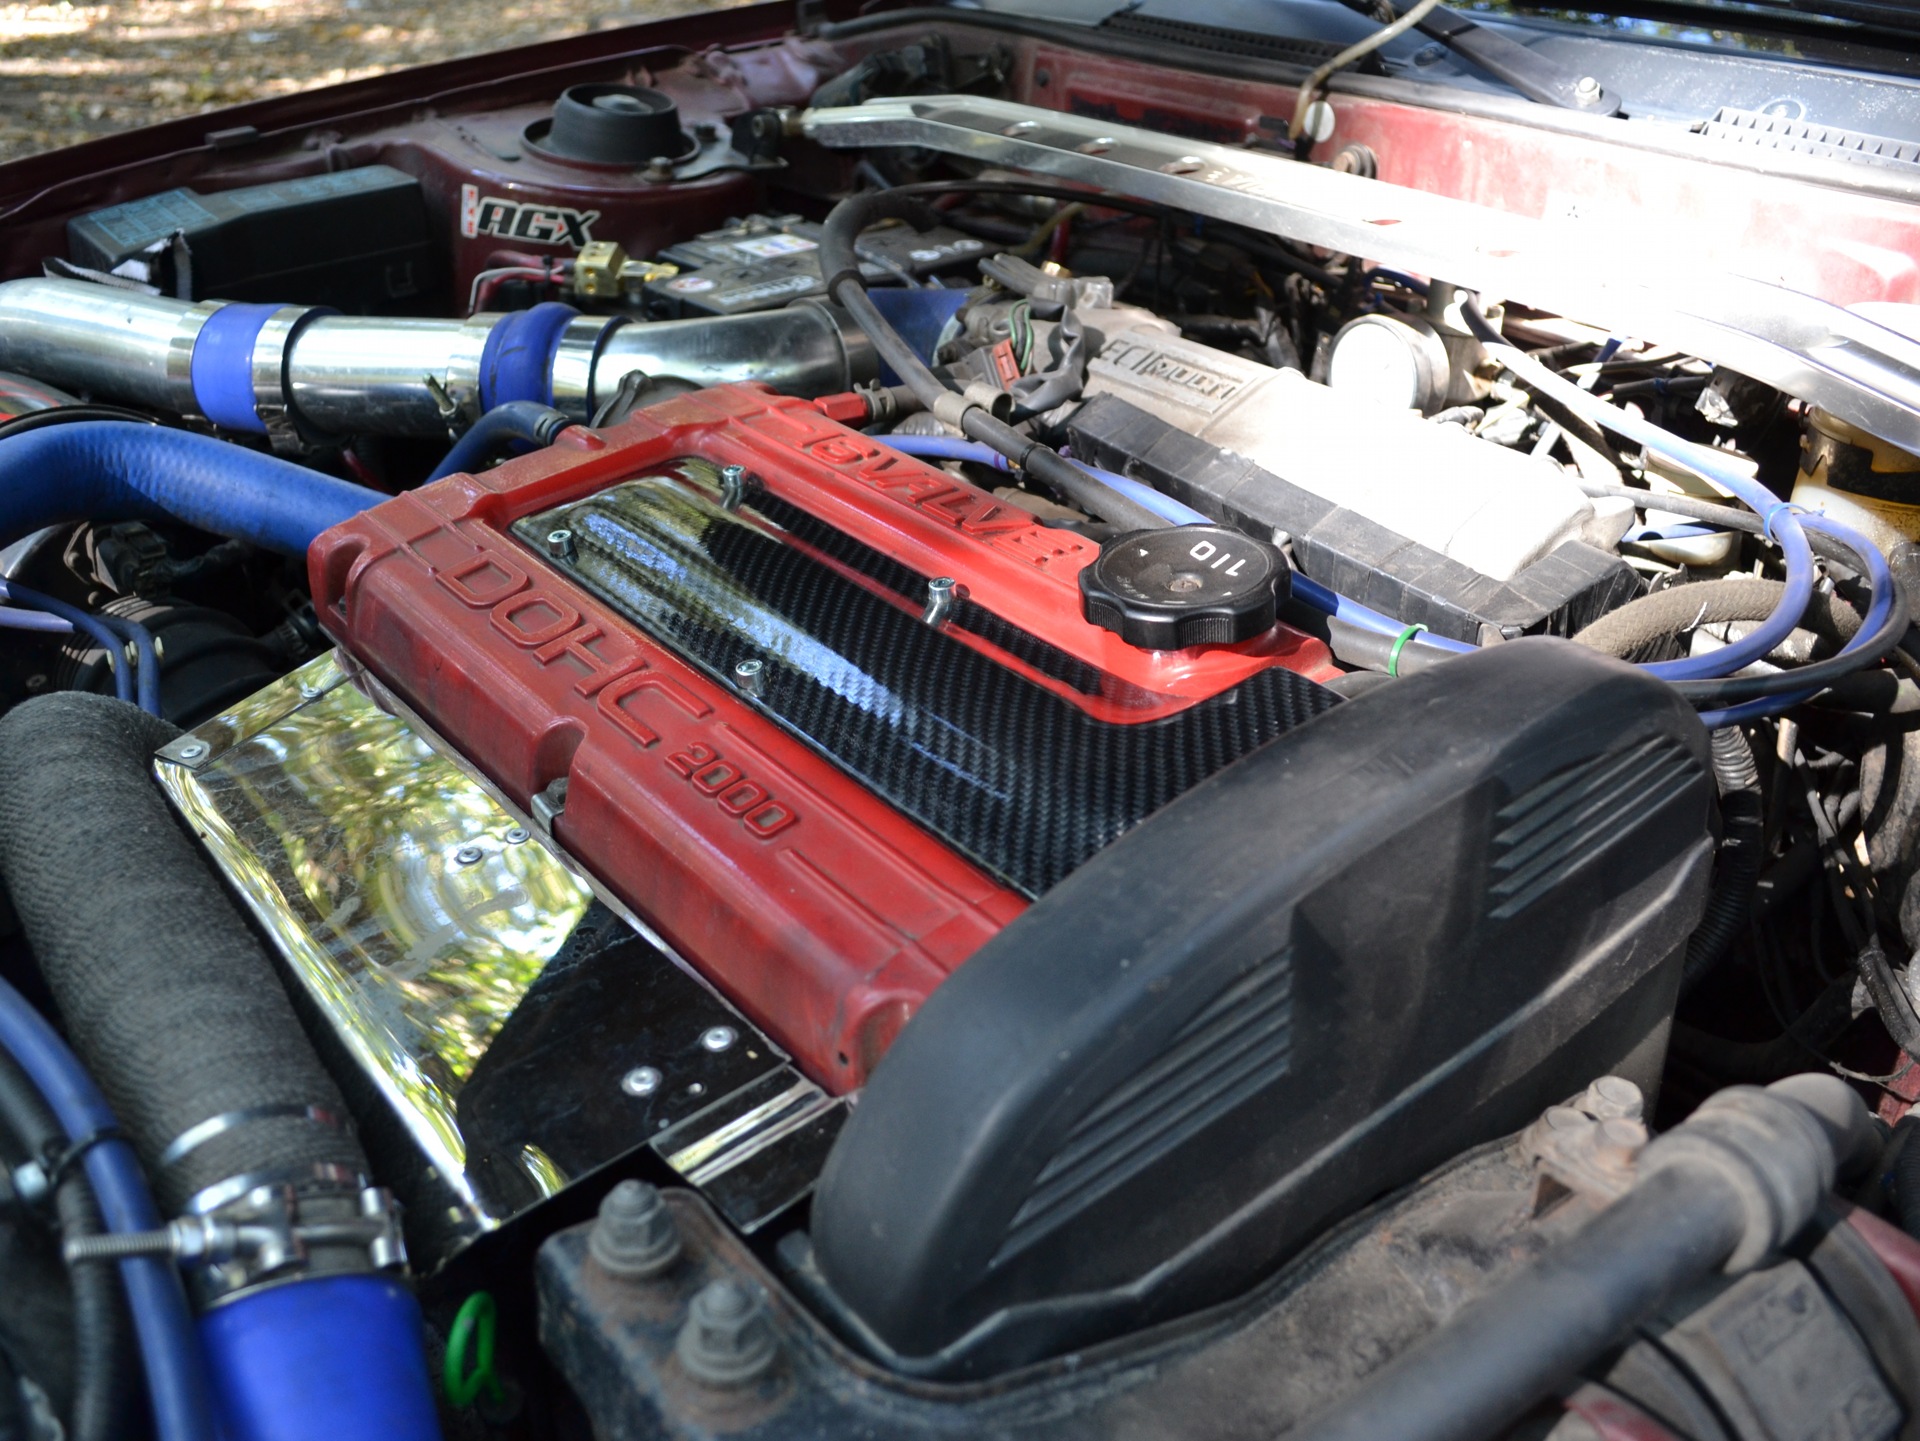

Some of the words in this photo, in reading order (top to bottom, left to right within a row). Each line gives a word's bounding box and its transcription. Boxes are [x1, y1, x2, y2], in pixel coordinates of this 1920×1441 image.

[476, 201, 598, 248] AGX
[1189, 540, 1247, 577] OIL
[435, 549, 713, 747] DOHC
[664, 740, 797, 838] 2000
